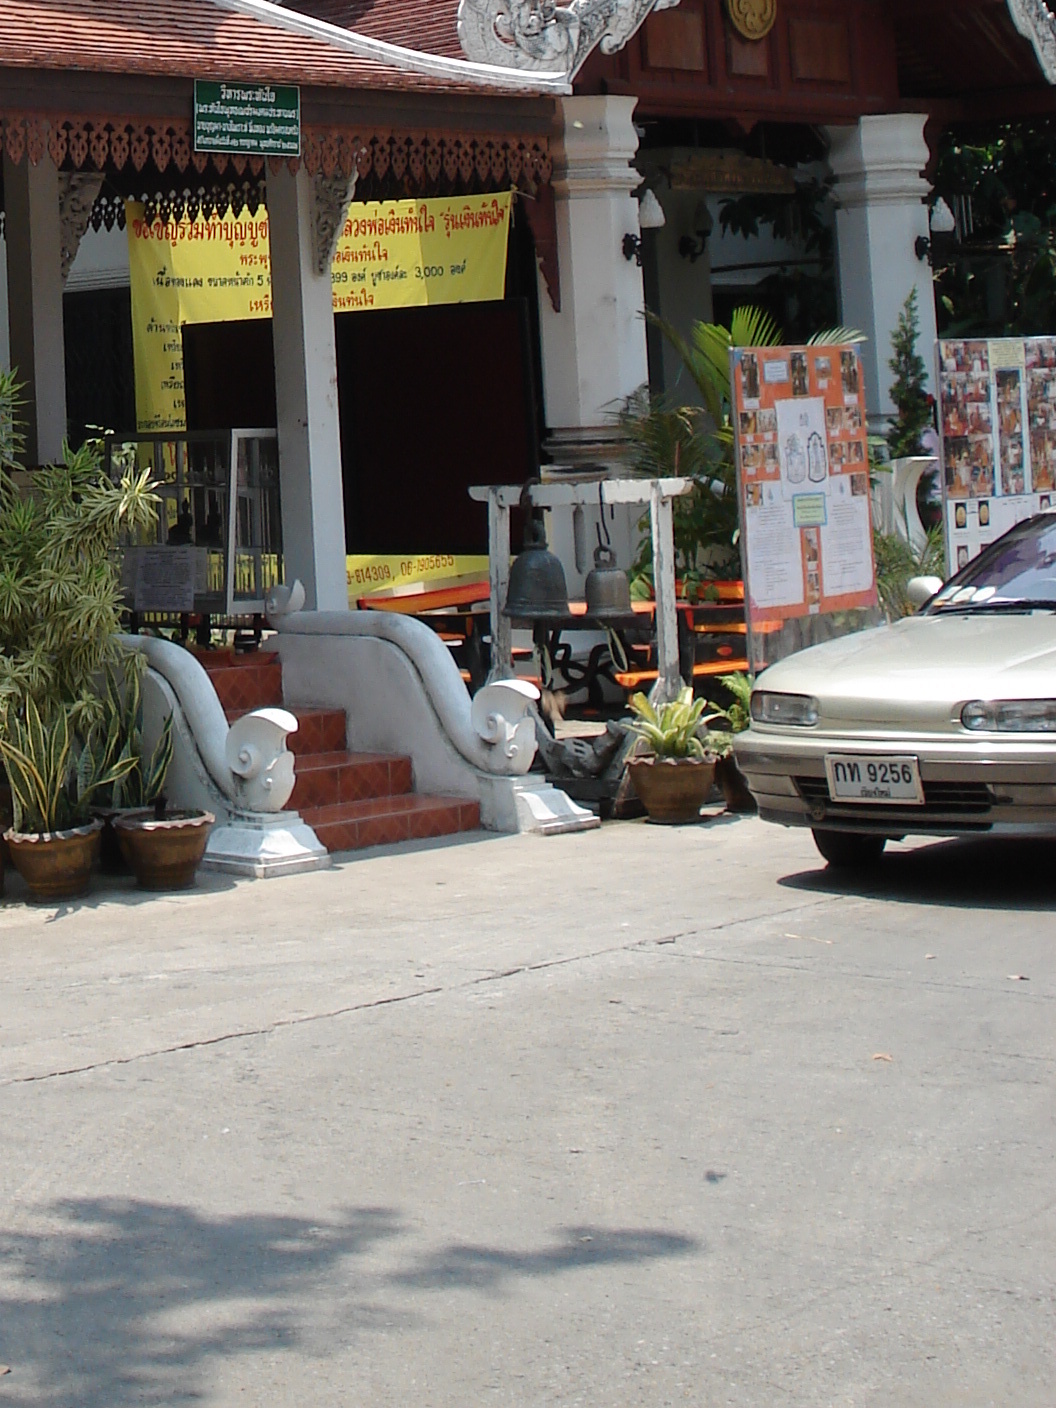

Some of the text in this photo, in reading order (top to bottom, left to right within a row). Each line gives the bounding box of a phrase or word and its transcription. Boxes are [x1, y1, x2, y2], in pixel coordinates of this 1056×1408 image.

[341, 204, 435, 238] ลวงพ่อเงินทันใจ
[239, 240, 388, 270] พระพุ อเงินทันใจ
[414, 265, 444, 280] 3,000
[248, 293, 272, 312] เหรี
[866, 763, 912, 784] 9256
